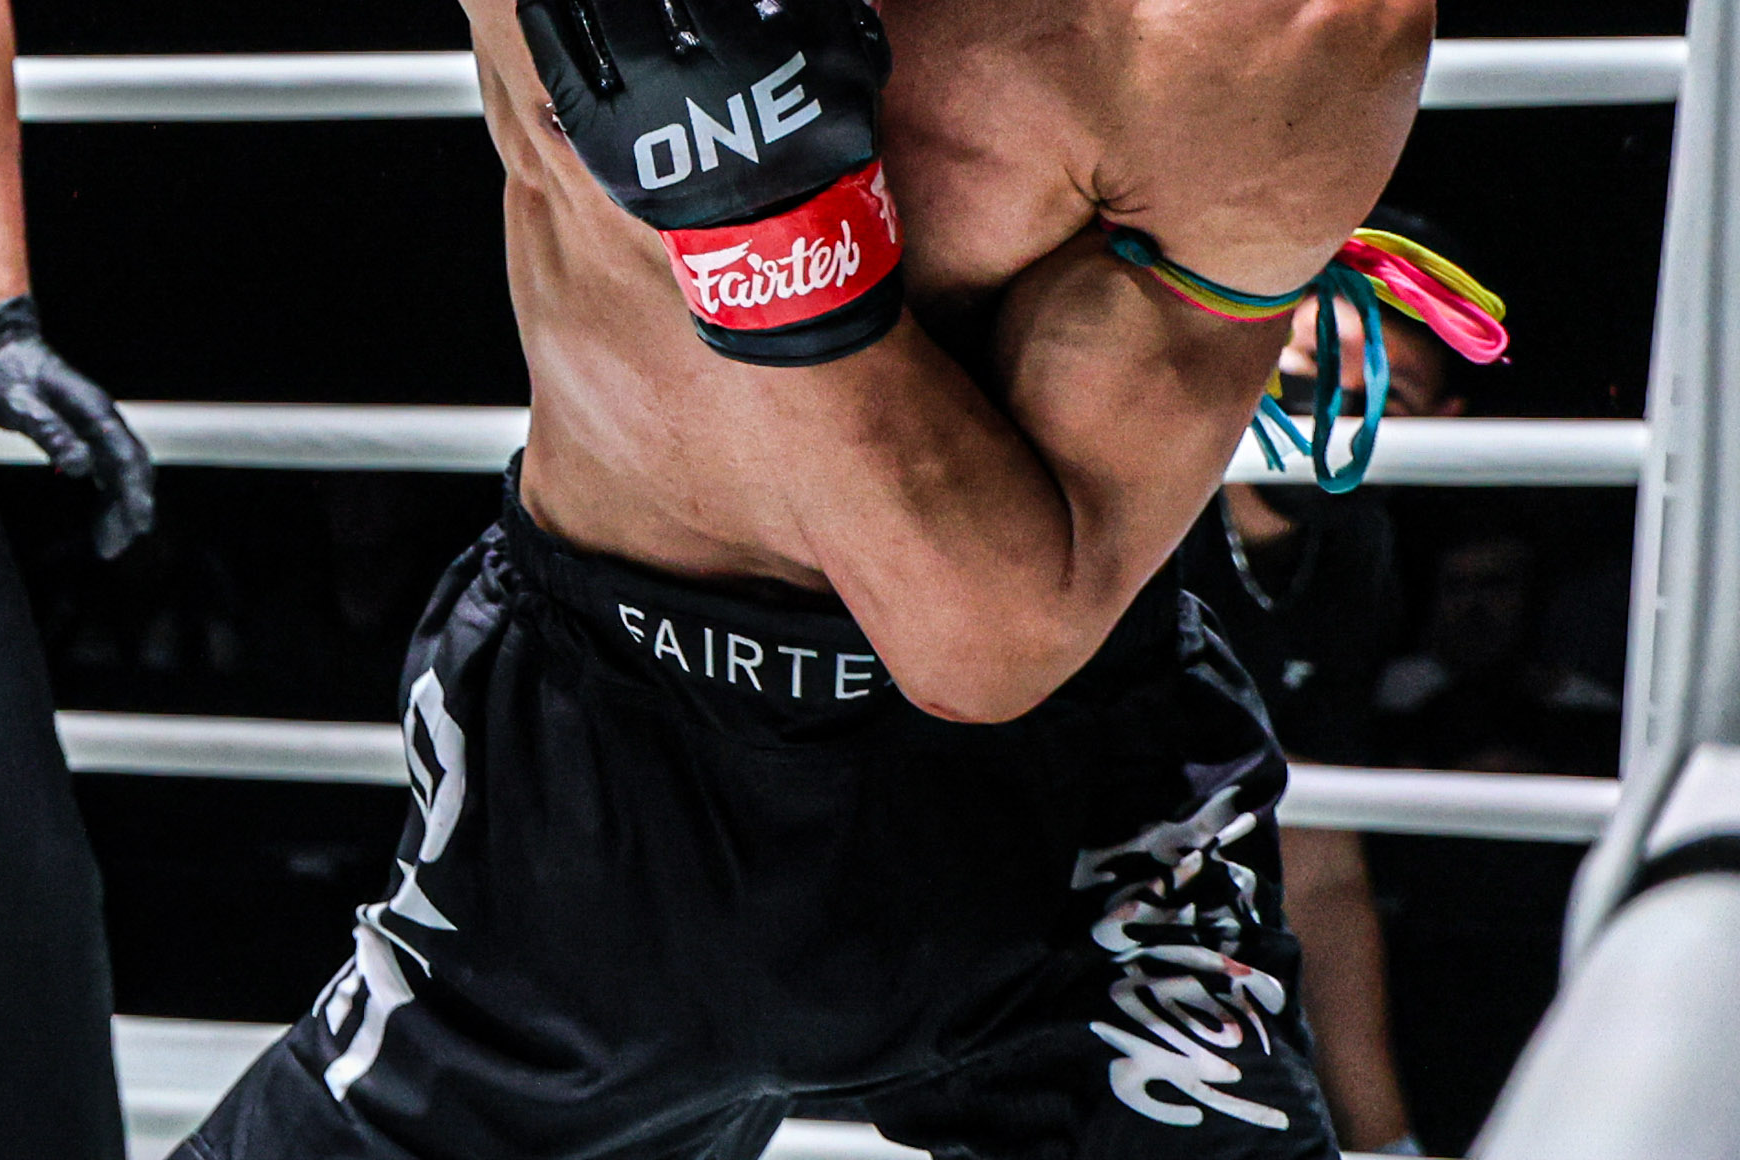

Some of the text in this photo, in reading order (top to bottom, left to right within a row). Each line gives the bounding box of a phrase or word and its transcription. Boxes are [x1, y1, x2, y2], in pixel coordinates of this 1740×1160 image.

[633, 51, 822, 190] ONE
[682, 220, 860, 315] Fairtex
[617, 603, 893, 700] FAIRTE
